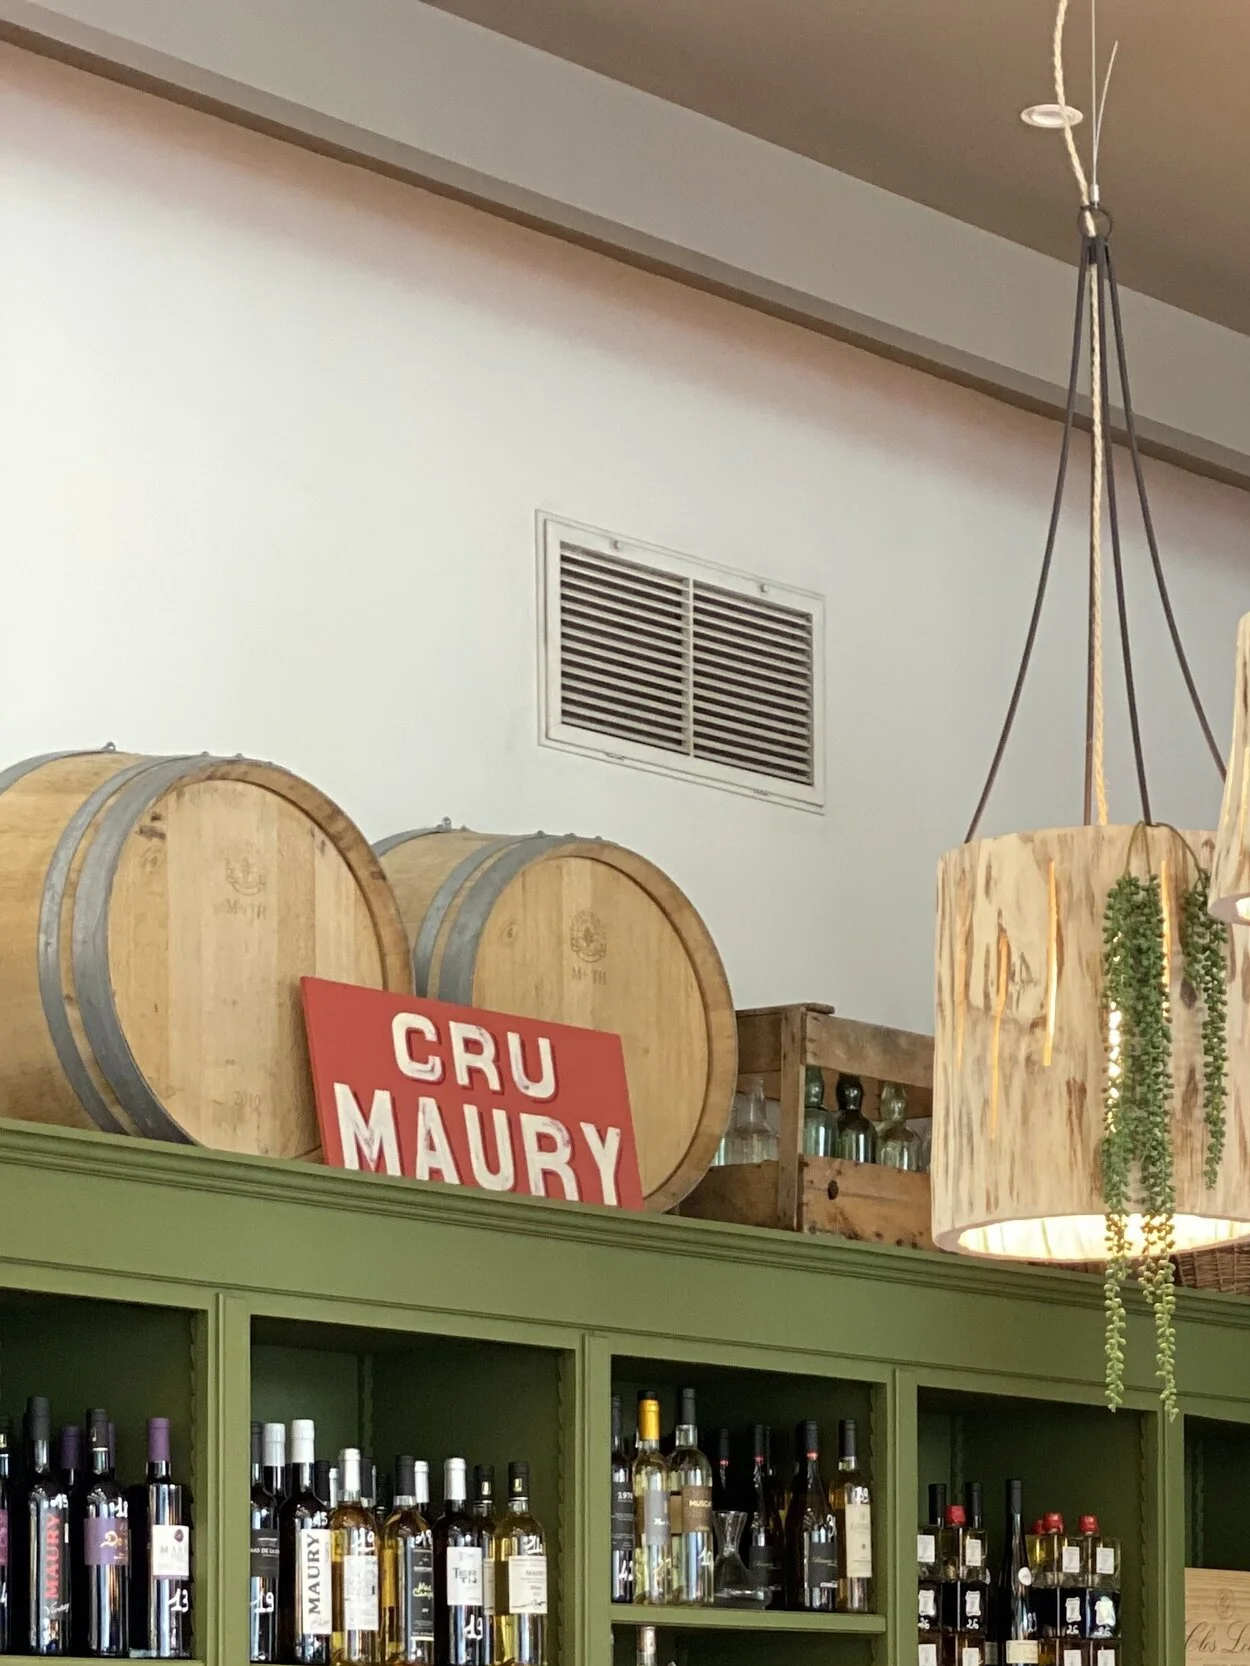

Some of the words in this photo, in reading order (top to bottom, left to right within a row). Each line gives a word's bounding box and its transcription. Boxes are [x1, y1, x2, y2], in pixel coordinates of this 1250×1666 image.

[391, 1011, 556, 1101] CRU
[333, 1081, 622, 1206] MAURY
[168, 1588, 190, 1613] 13
[307, 1533, 322, 1616] MAURY
